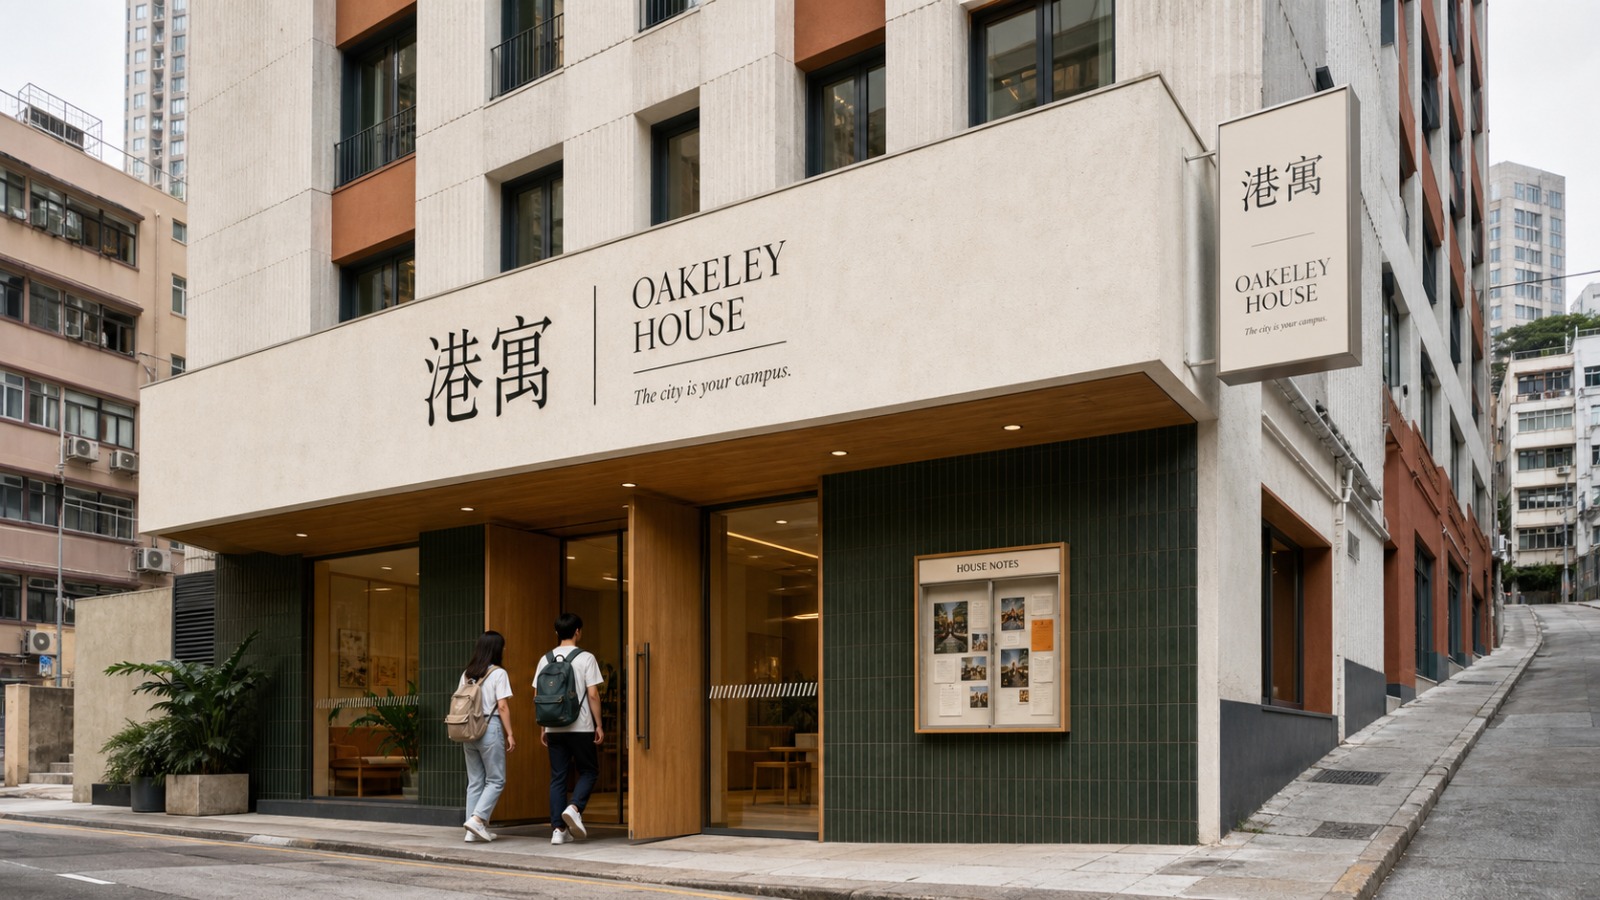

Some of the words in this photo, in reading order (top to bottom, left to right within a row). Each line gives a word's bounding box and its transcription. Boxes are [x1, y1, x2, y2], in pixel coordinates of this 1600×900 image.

[1241, 154, 1323, 212] 港寓
[632, 239, 787, 310] OAKELEY
[1235, 257, 1331, 293] OAKELEY
[1245, 283, 1318, 314] HOUSE
[633, 296, 747, 354] HOUSE
[1245, 326, 1258, 336] The
[1258, 324, 1272, 335] city
[1273, 322, 1279, 331] is
[1280, 320, 1298, 332] your
[1299, 316, 1328, 326] campus.
[424, 315, 553, 427] 港寓
[634, 387, 657, 406] The
[660, 383, 684, 403] city
[687, 379, 698, 396] is
[699, 376, 732, 399] your
[735, 365, 792, 388] campus.
[956, 562, 988, 573] HOUSE
[989, 559, 1019, 571] NOTES
